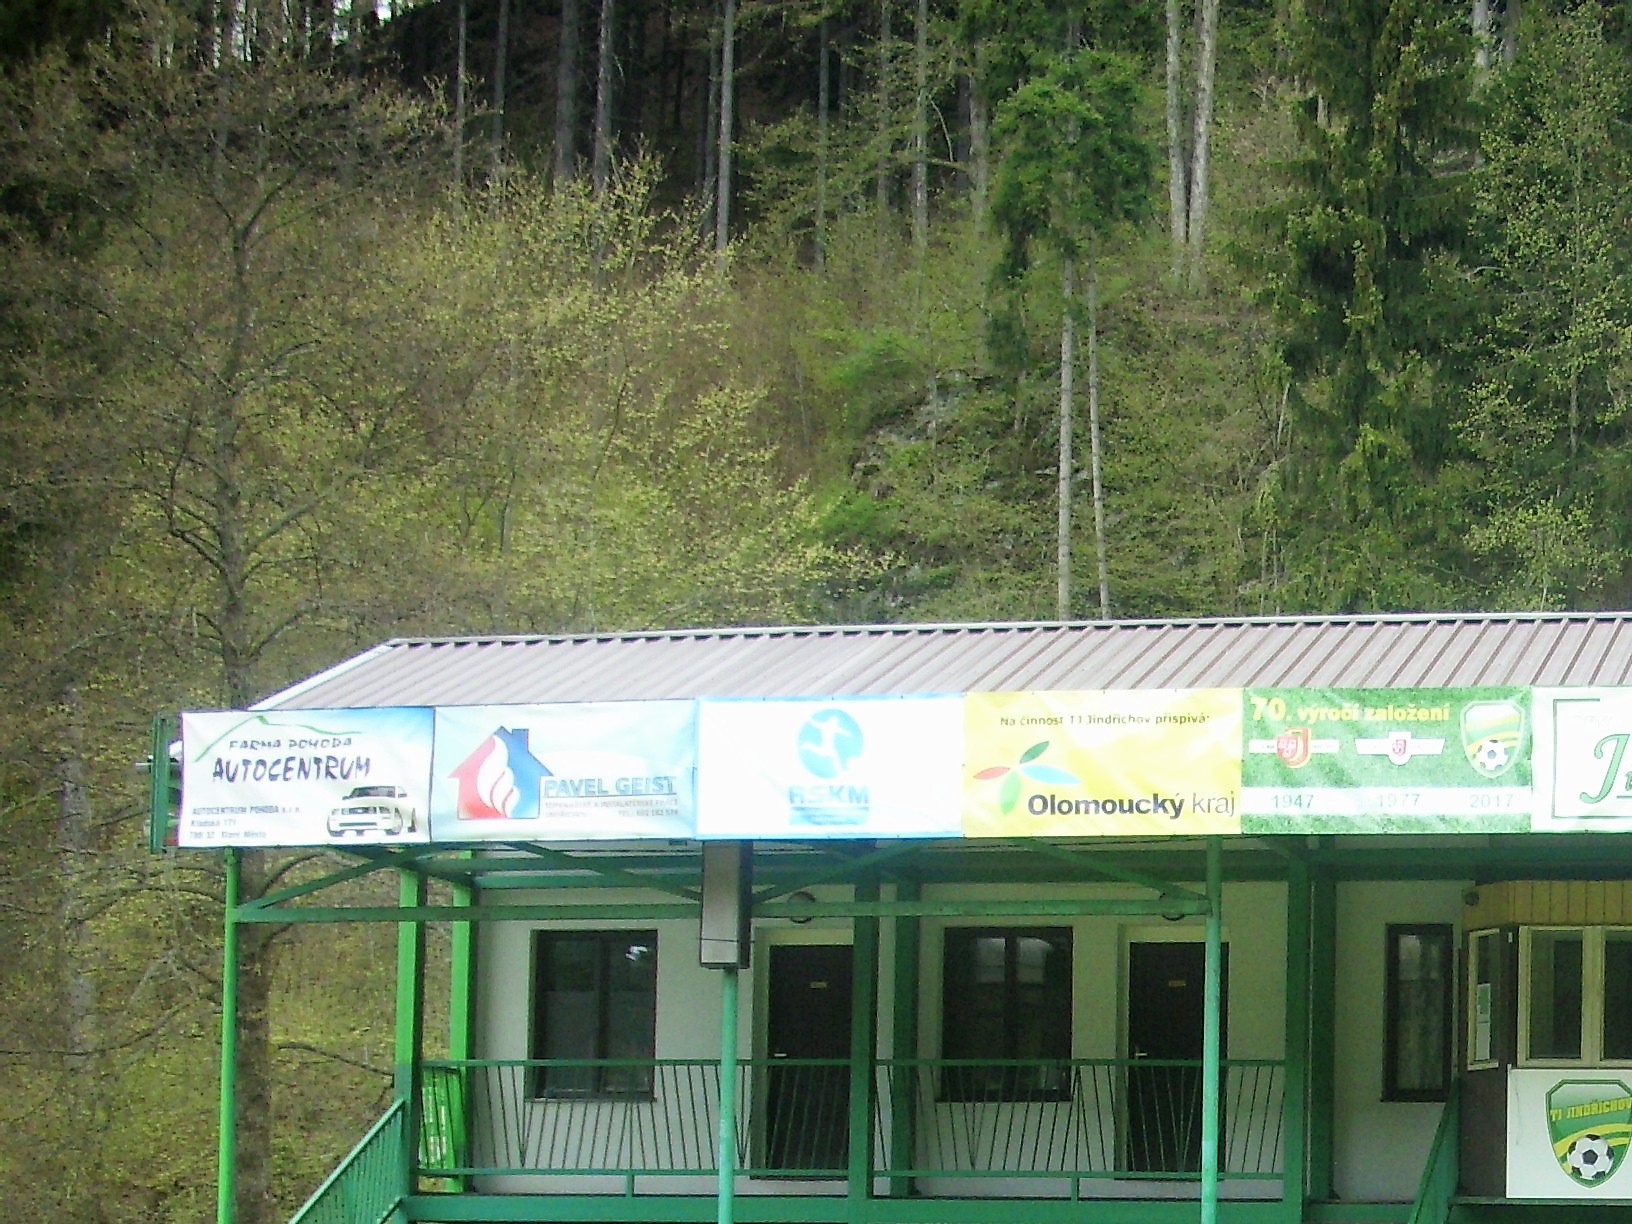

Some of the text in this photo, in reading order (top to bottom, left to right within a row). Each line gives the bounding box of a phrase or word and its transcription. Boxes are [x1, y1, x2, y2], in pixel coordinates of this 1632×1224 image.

[1251, 696, 1450, 721] 70. výročí založení
[1000, 716, 1015, 726] Na
[1020, 714, 1063, 726] činnost
[1088, 713, 1150, 725] Jindřichov
[229, 740, 282, 750] FARMA
[213, 756, 370, 783] AUTOCENTRUM
[544, 776, 677, 797] PAVEL GEIST
[1027, 790, 1235, 819] Olomoucký kraj
[1273, 794, 1314, 809] 1947
[1378, 794, 1420, 808] 1977
[1470, 794, 1514, 808] 2017
